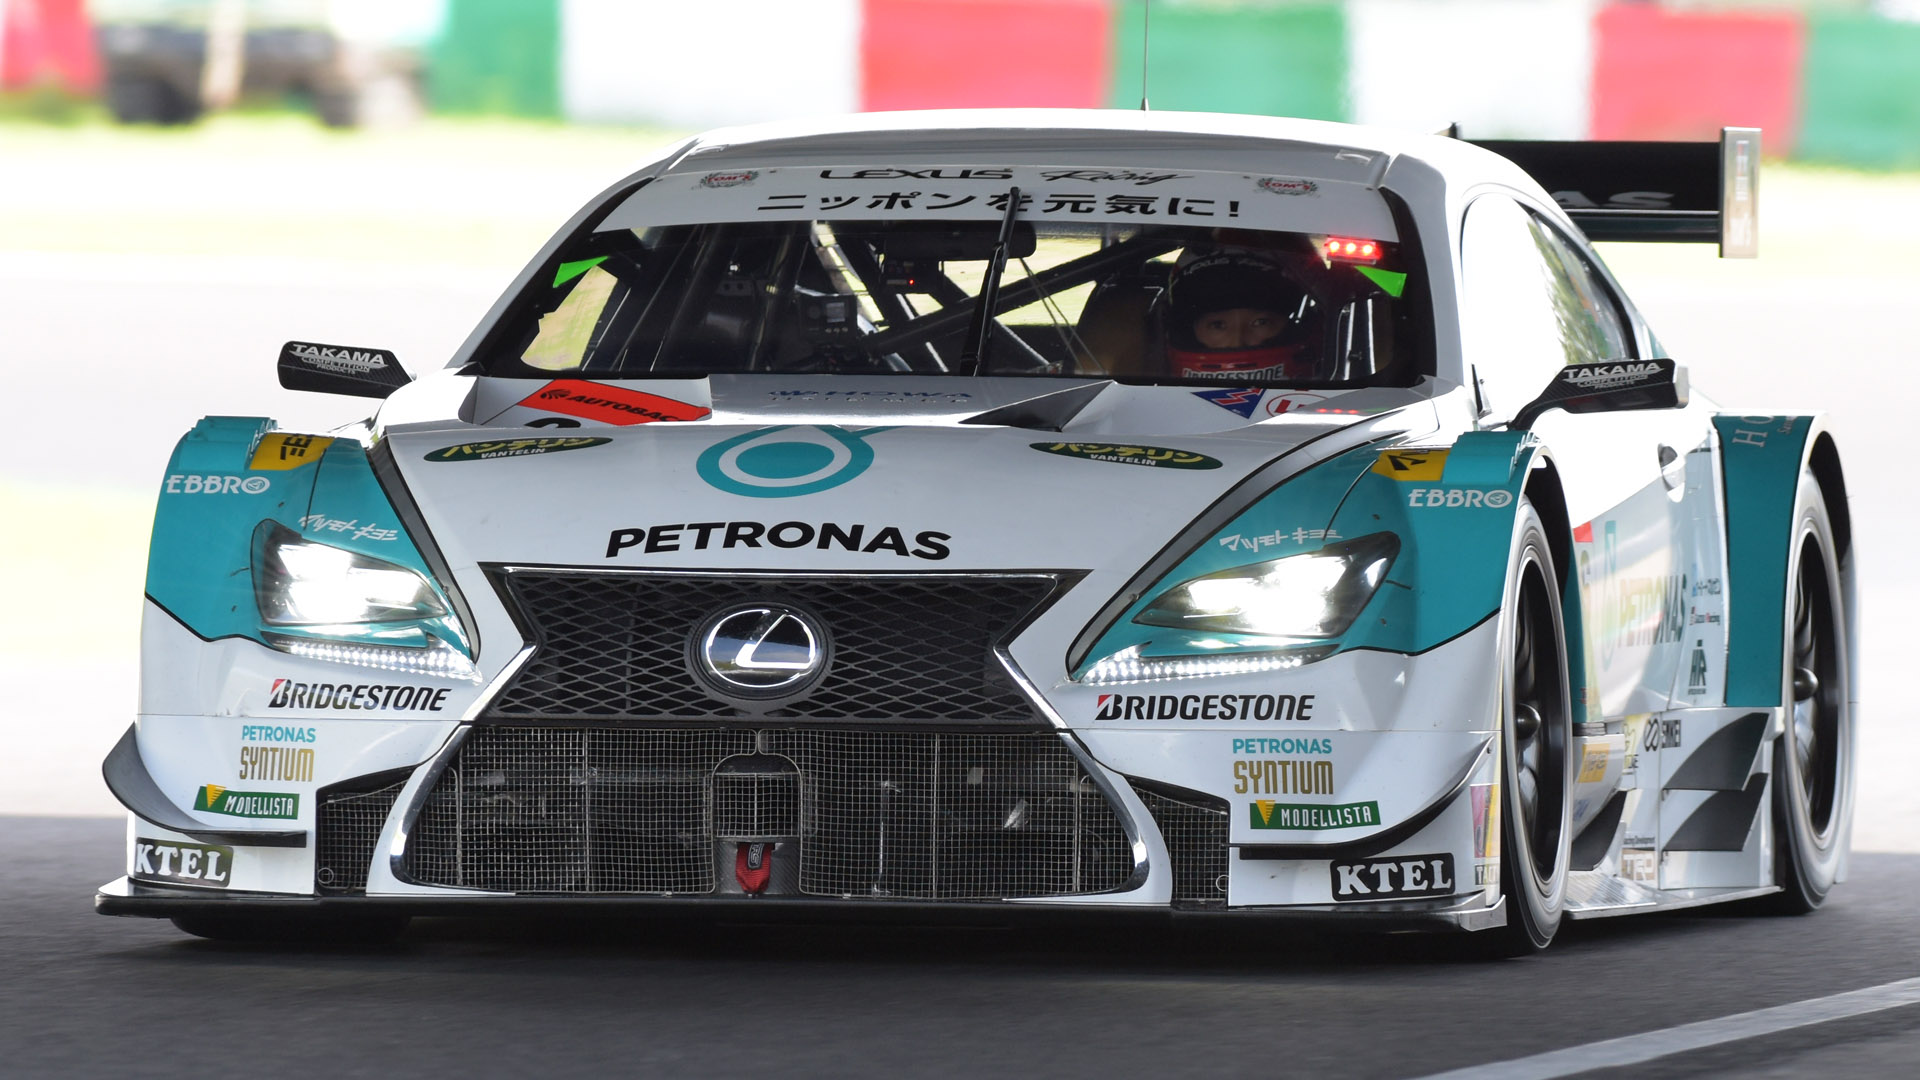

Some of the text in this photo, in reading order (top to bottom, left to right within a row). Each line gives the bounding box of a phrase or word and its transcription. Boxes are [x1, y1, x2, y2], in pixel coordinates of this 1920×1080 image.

[820, 168, 1195, 186] LEXUS Racing
[292, 343, 385, 365] TAKAMA
[301, 356, 370, 373] COMPETITION
[1563, 361, 1661, 380] TAKAMA
[442, 437, 595, 458] バンテリン
[480, 448, 546, 459] VANTELIN
[1049, 442, 1204, 463] バンテリン
[1089, 453, 1156, 466] VANTELIN
[166, 474, 270, 494] EBBRO
[1407, 488, 1513, 508] EBBRO
[606, 521, 952, 560] PETRONAS
[268, 678, 453, 711] BRIDGESTONE
[1095, 694, 1315, 721] BRIDGESTONE
[241, 725, 316, 743] PETRONAS
[1232, 737, 1333, 755] PETRONAS
[239, 746, 315, 782] SYNTIUM
[1233, 760, 1334, 795] SYNTIUM
[224, 795, 294, 817] MODELLISTA
[1280, 805, 1372, 828] MODELLISTA
[135, 842, 227, 883] KTEL
[1336, 859, 1453, 896] KTEL
